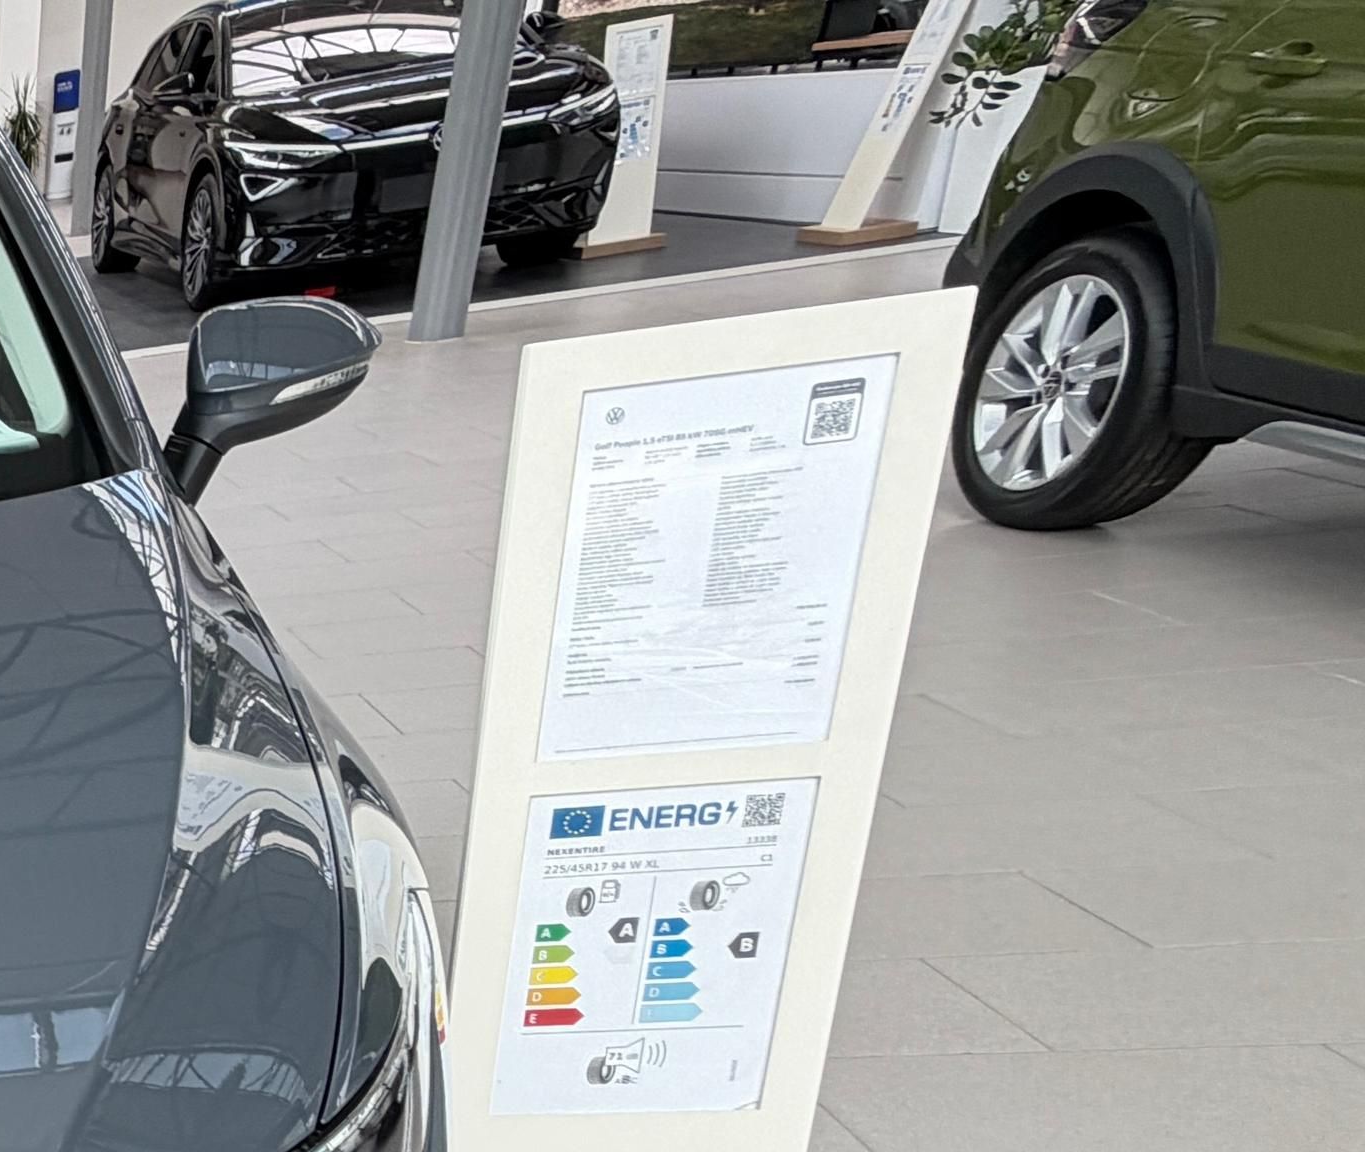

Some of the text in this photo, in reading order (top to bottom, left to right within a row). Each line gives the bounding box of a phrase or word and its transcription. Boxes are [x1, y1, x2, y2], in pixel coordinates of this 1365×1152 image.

[608, 801, 722, 832] ENERG
[546, 846, 606, 857] NEXENTIRE
[544, 860, 659, 875] 225/45R17 94 W XL
[619, 922, 635, 938] A
[658, 922, 671, 933] A
[540, 928, 551, 939] A
[739, 937, 754, 953] B
[652, 966, 662, 977] C
[532, 991, 542, 1002] D
[649, 987, 660, 998] D
[529, 1013, 538, 1024] E
